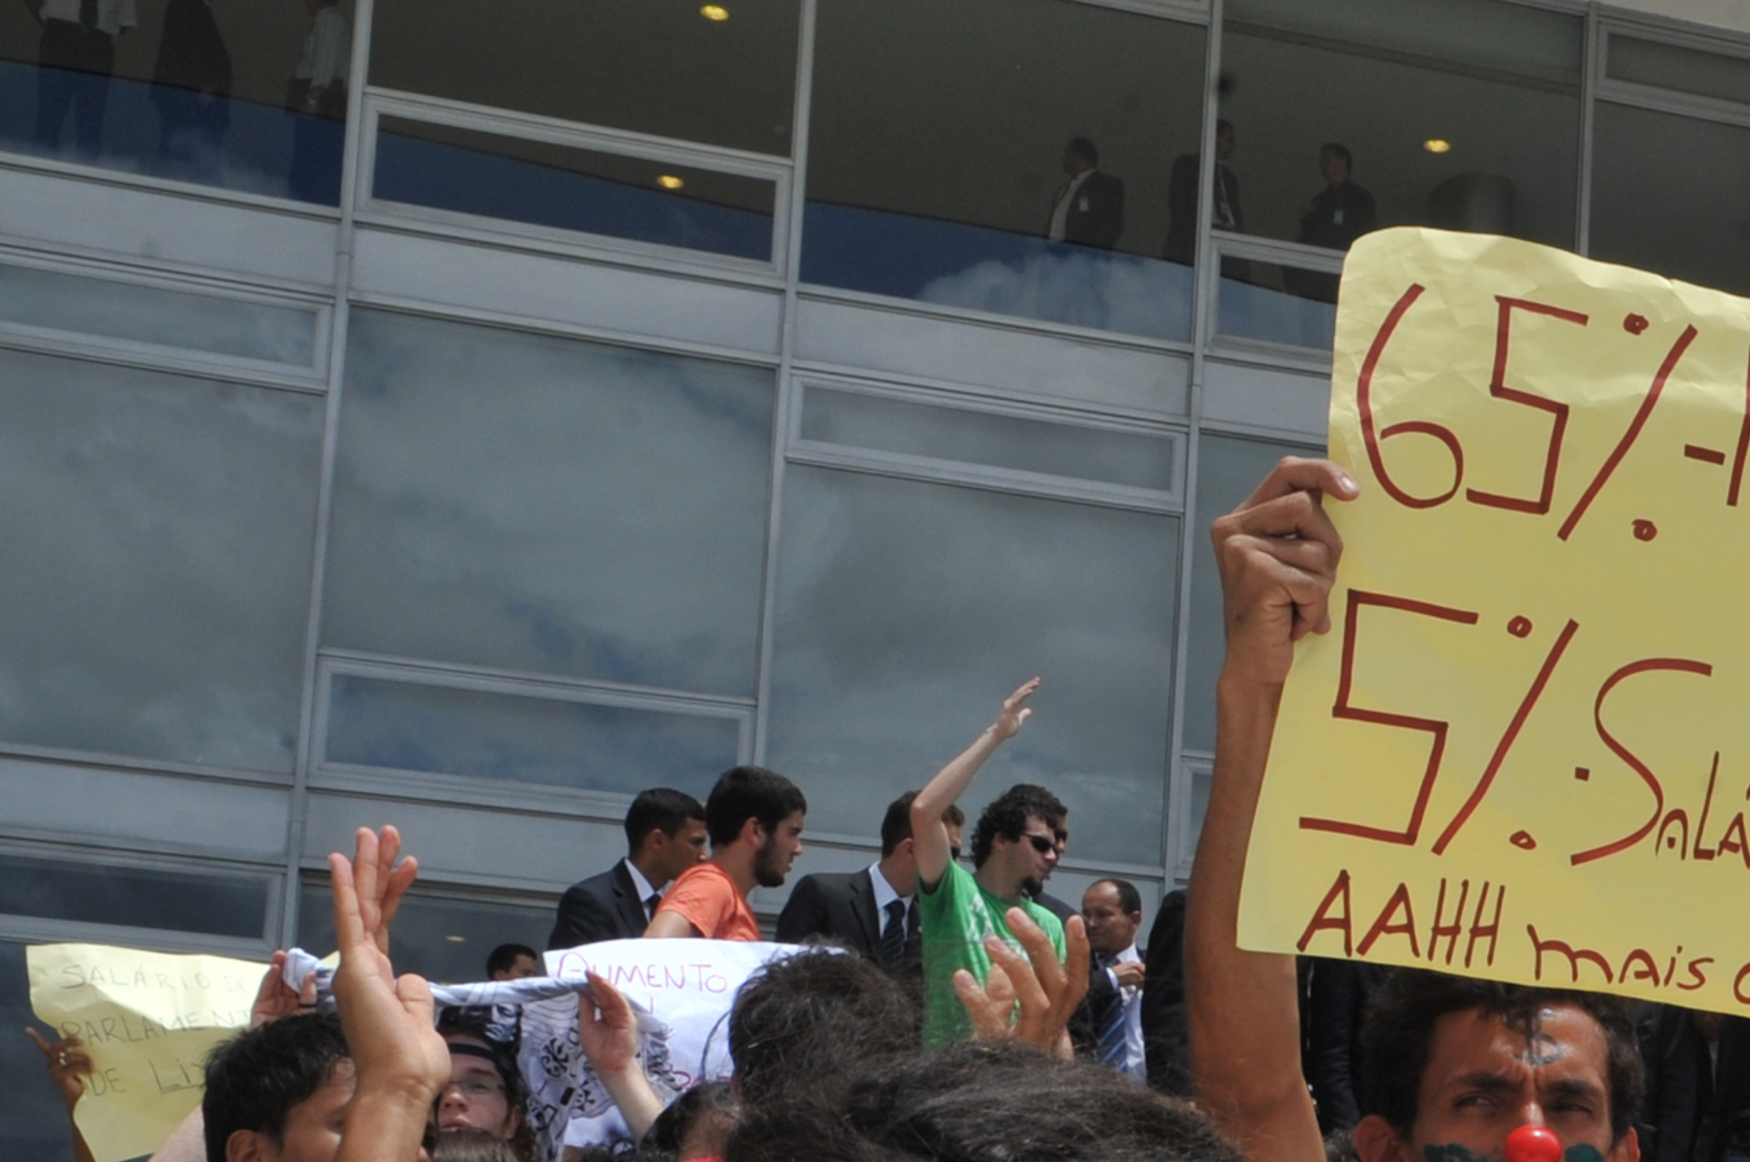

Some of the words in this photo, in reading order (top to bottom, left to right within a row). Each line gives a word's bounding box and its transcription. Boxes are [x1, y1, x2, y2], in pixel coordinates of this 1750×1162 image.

[1357, 283, 1698, 542] 65%
[1299, 588, 1579, 856] 5%
[1296, 869, 1506, 968] AAHH
[60, 964, 211, 989] SALÁRIO
[90, 1067, 127, 1097] DE
